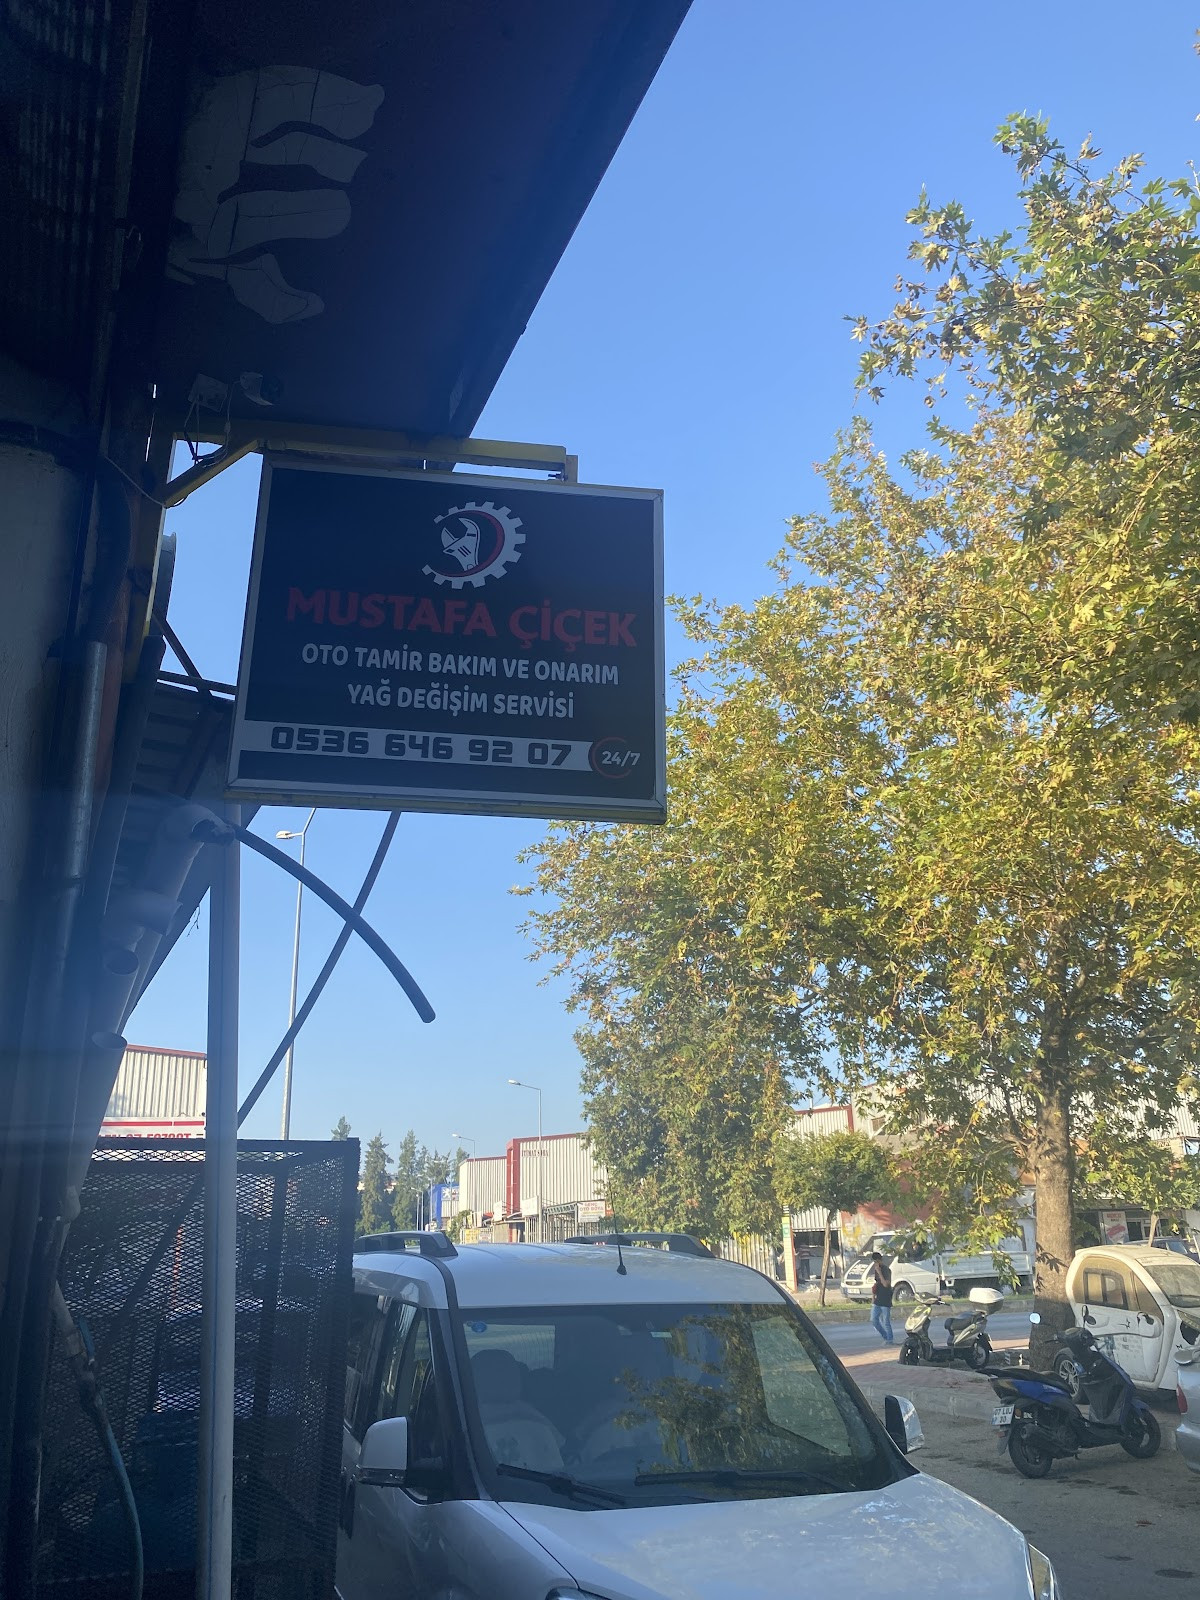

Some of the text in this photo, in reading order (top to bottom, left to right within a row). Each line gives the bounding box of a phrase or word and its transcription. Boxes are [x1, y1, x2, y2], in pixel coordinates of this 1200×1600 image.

[287, 587, 637, 652] MUSTAFA ÇİÇEK
[301, 643, 619, 685] OTO TAMİR BAKIM VE ONARIM
[347, 678, 574, 719] YAĞ DEĞİŞİM SERVİSİ
[270, 726, 572, 766] 0536 646 92 07
[602, 750, 641, 767] 24/7
